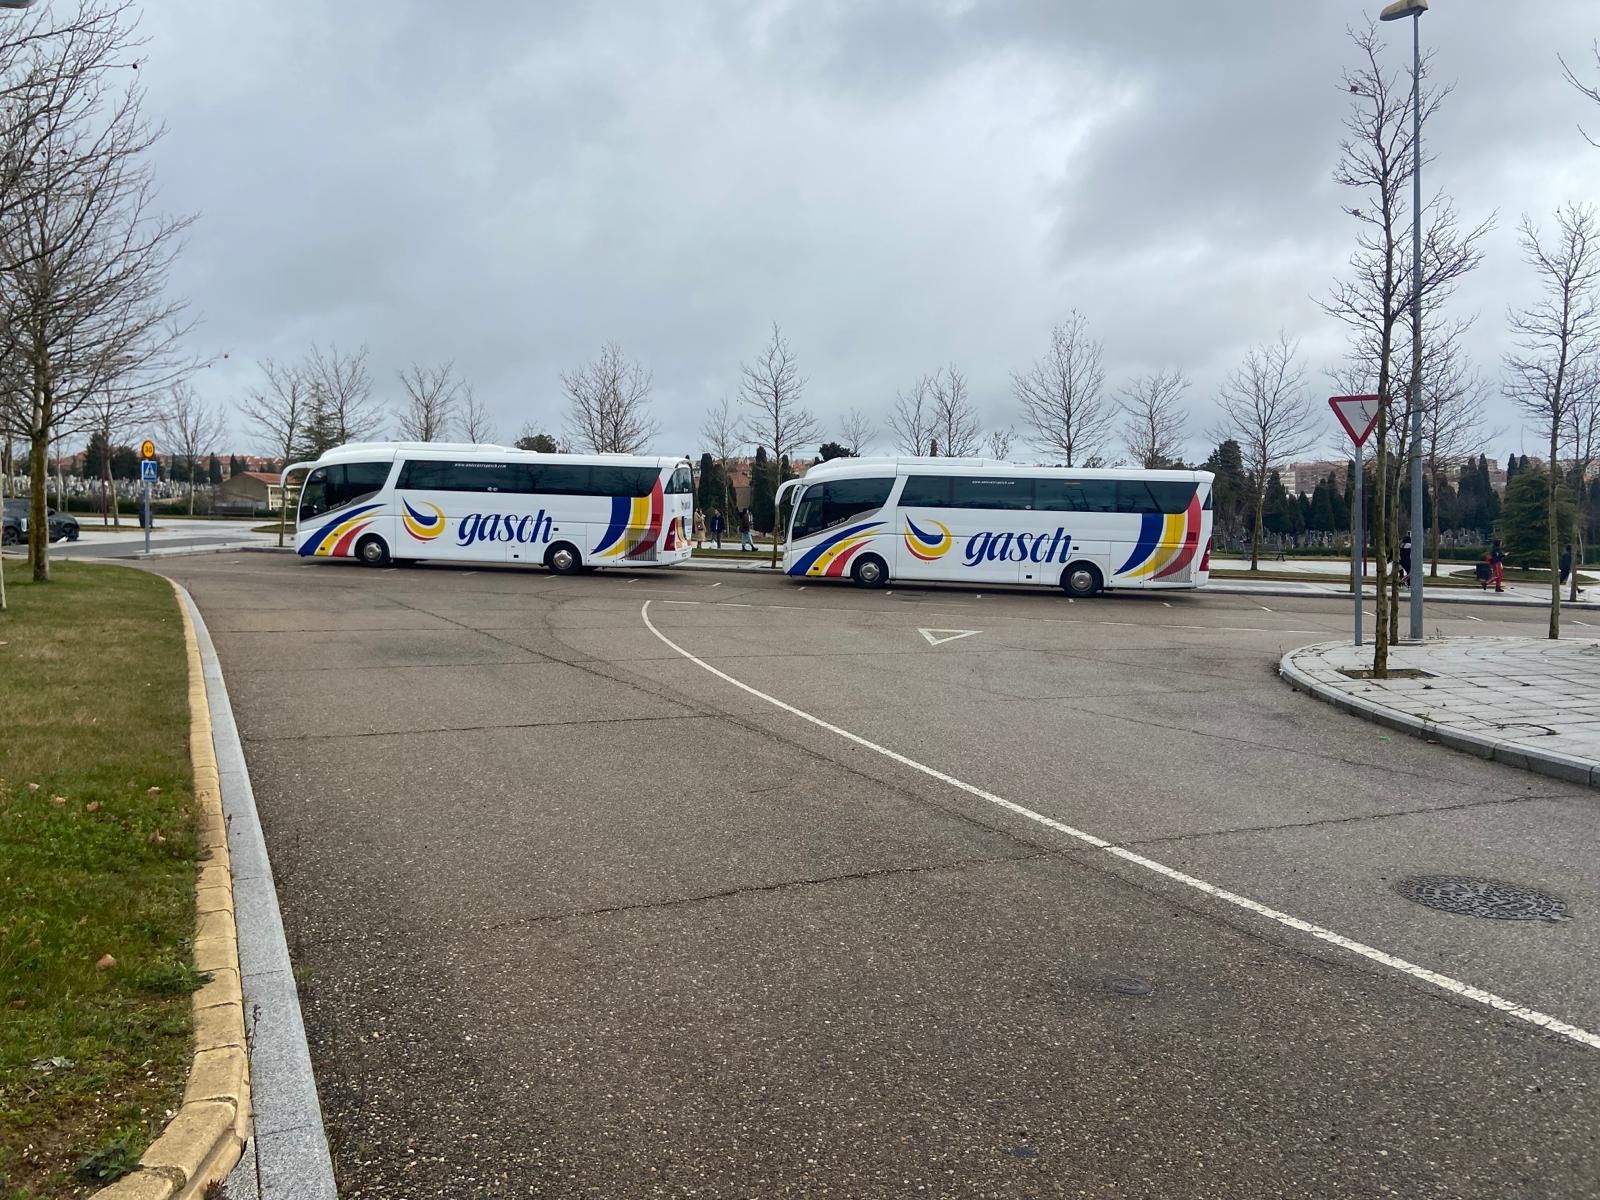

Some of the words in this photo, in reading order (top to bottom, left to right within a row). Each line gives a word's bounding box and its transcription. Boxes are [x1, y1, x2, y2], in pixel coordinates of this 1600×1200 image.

[144, 445, 153, 454] 30
[456, 509, 553, 547] gasch
[962, 527, 1072, 567] gasch
